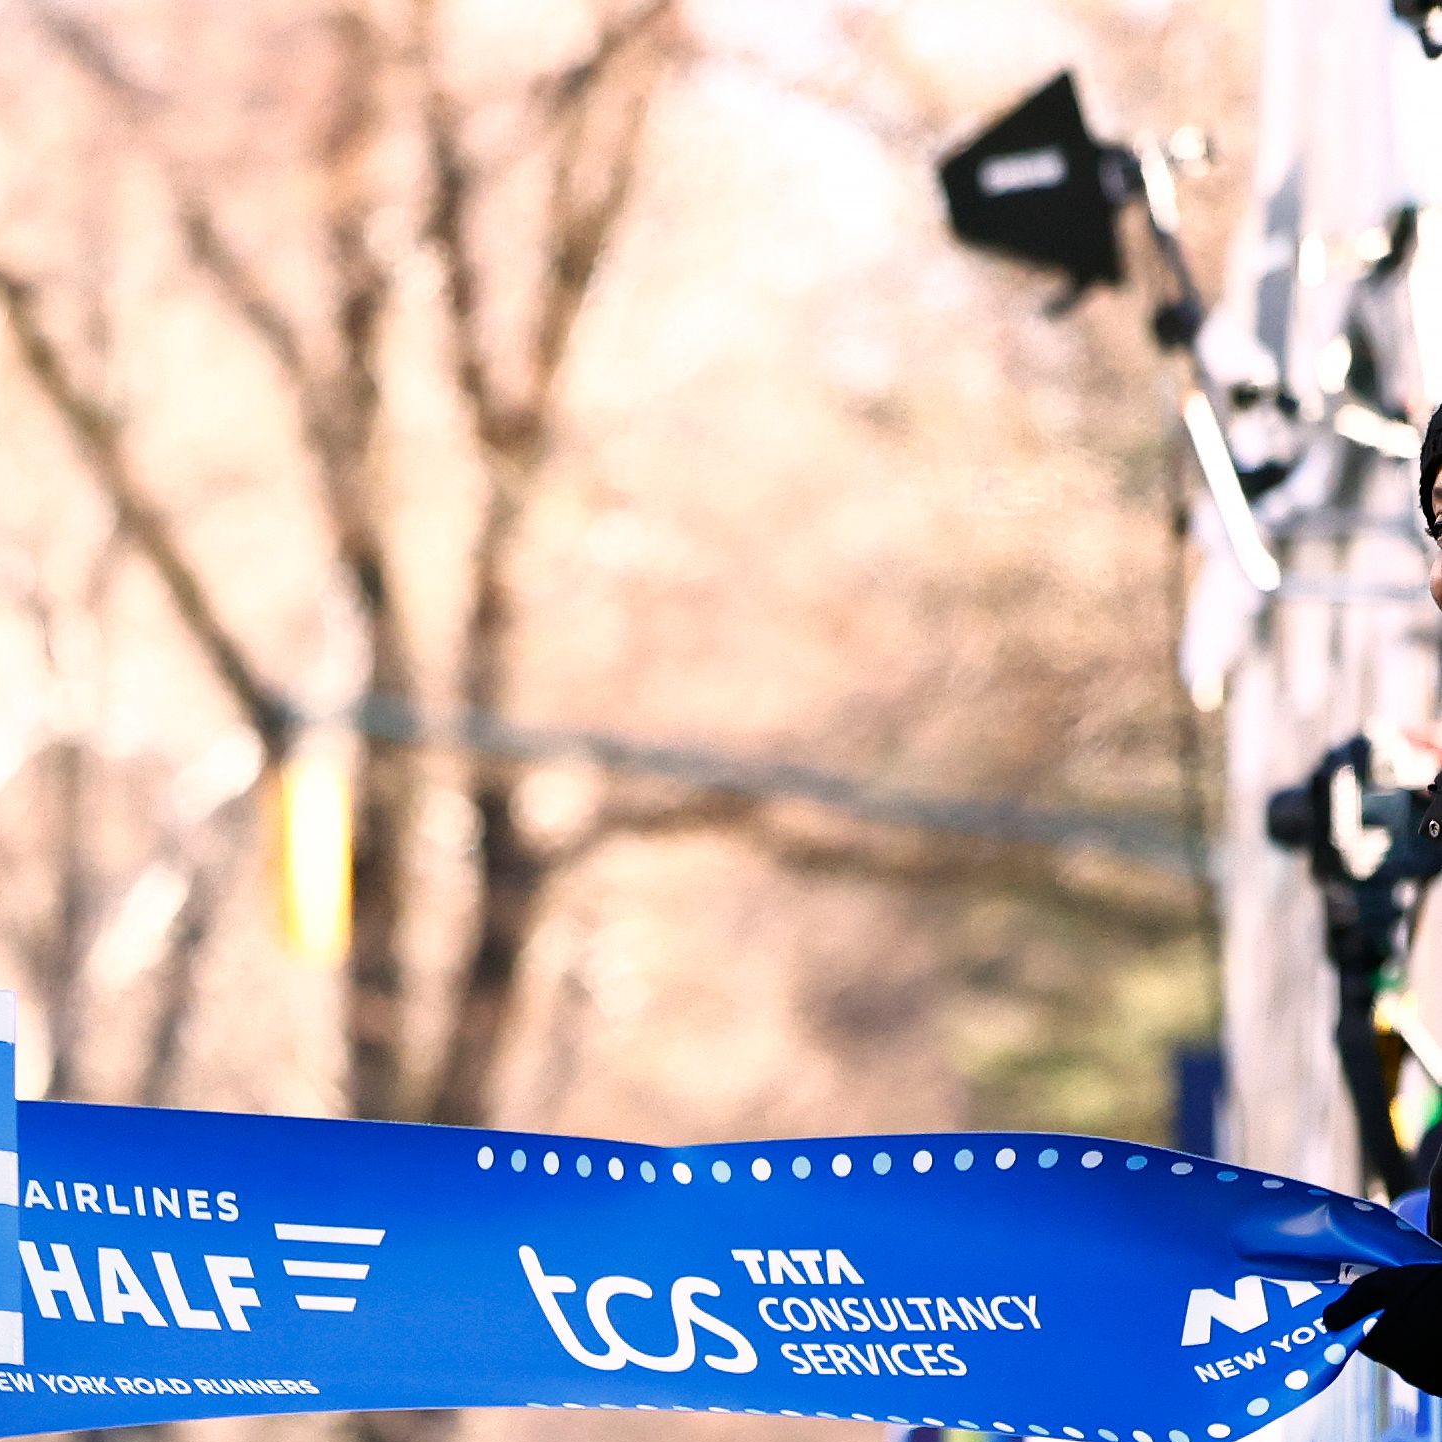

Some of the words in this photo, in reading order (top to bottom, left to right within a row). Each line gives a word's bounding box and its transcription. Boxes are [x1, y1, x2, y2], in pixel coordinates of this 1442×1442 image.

[24, 1179, 240, 1222] AIRLINES
[17, 1239, 262, 1332] HALF
[731, 1249, 865, 1285] TATA
[518, 1245, 758, 1374] tcs
[757, 1295, 1043, 1333] CONSULTANCY
[780, 1342, 968, 1377] SERVICES
[1193, 1346, 1267, 1383] NEW
[40, 1373, 116, 1395] YORK
[113, 1376, 192, 1396] ROAD
[194, 1378, 321, 1396] RUNNERS
